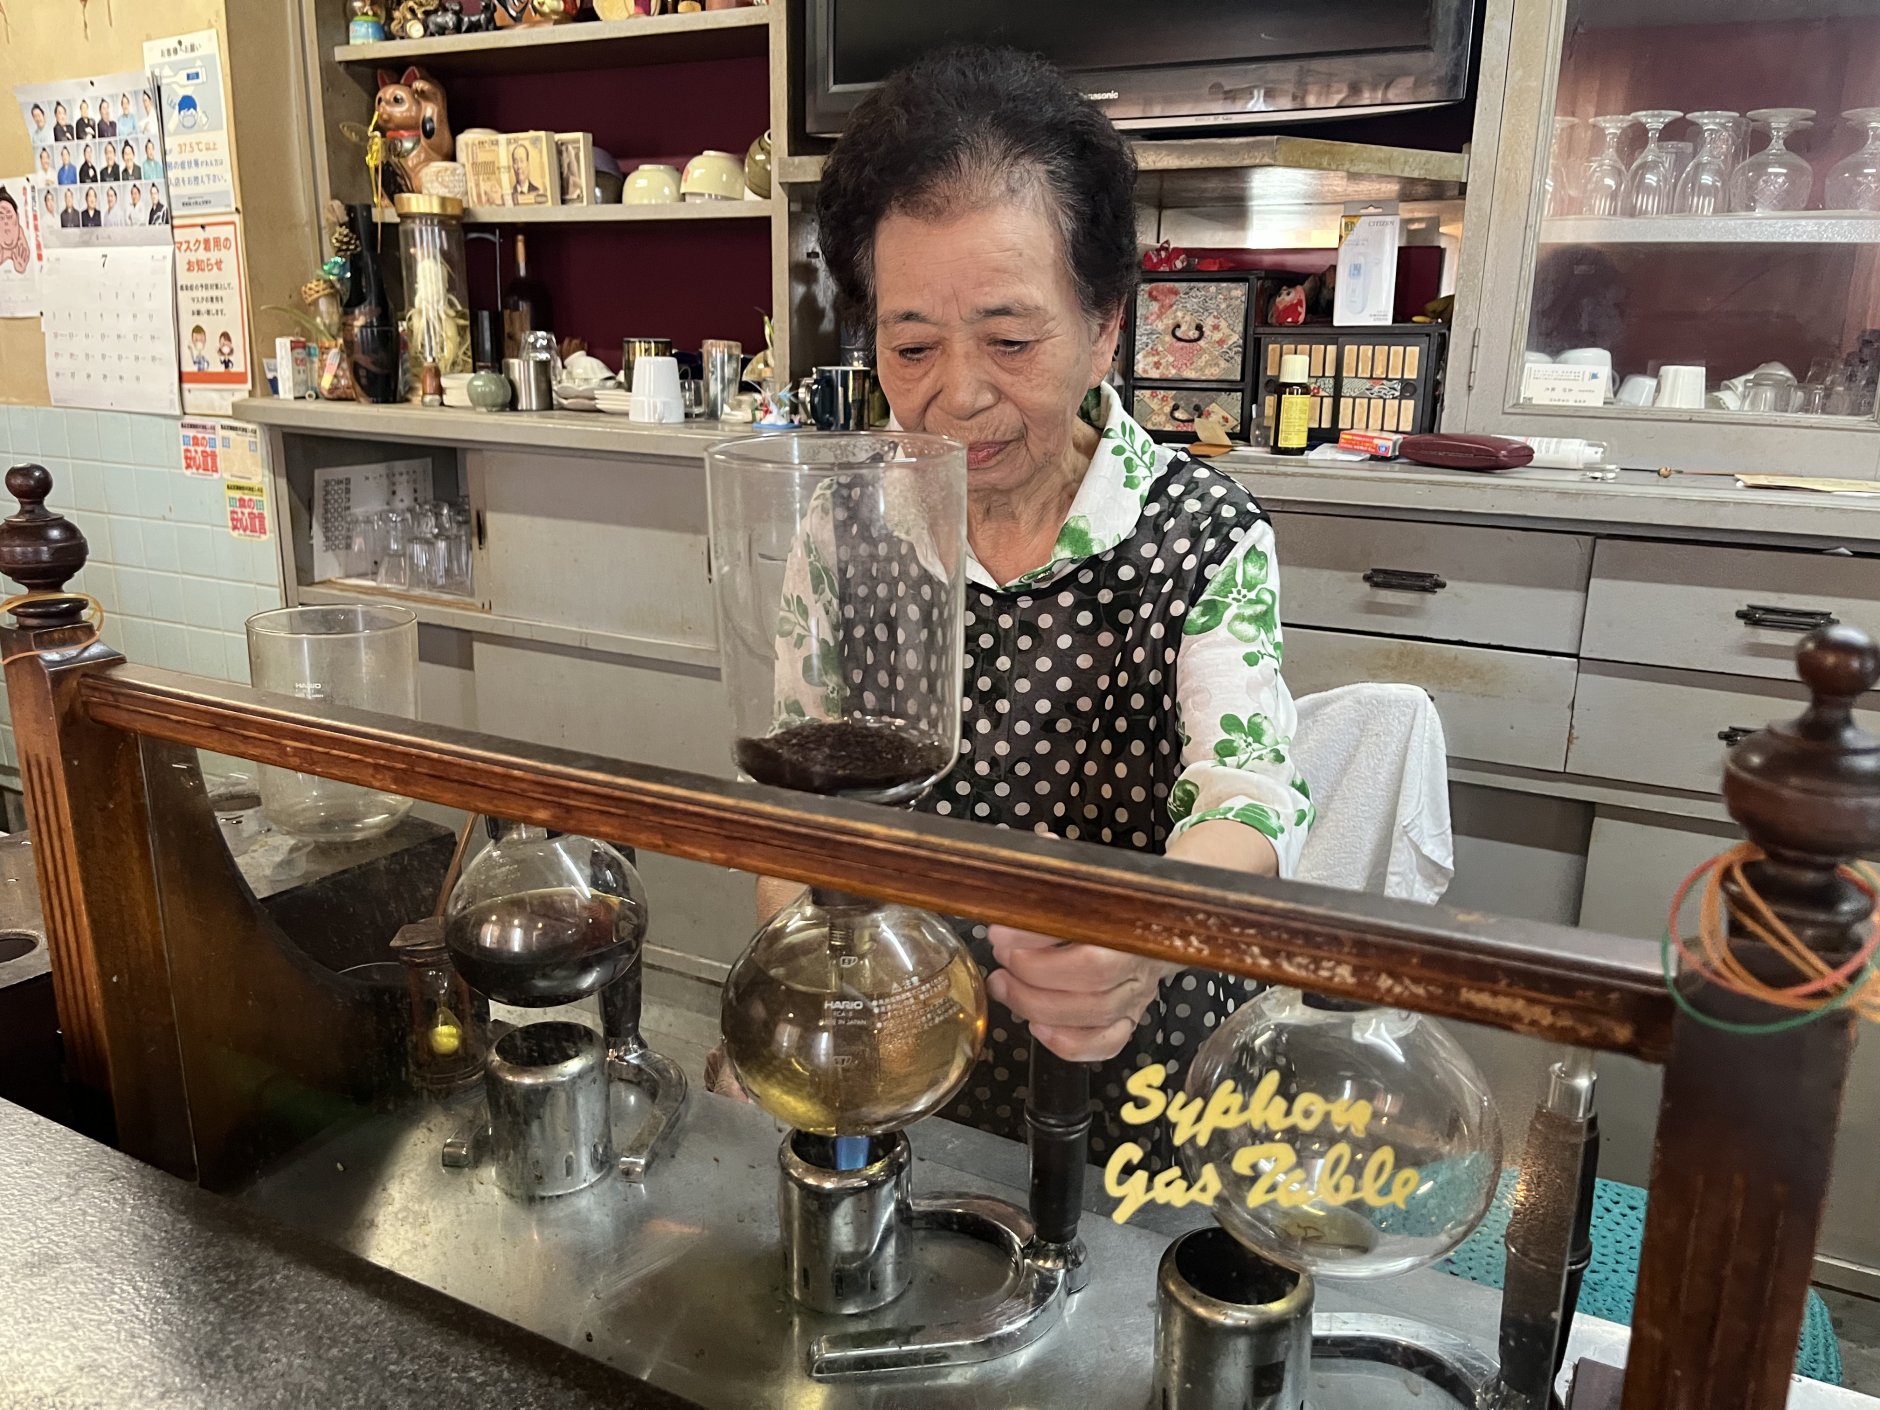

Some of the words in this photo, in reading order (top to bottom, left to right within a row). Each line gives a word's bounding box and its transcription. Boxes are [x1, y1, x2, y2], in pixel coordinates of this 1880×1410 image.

[175, 237, 231, 252] マスク着用の
[101, 254, 108, 268] 7
[186, 257, 223, 272] お知らせ
[824, 1000, 864, 1010] HARIO
[1119, 1063, 1374, 1147] Syphon
[1104, 1141, 1222, 1225] Gas
[1231, 1141, 1421, 1210] Table
